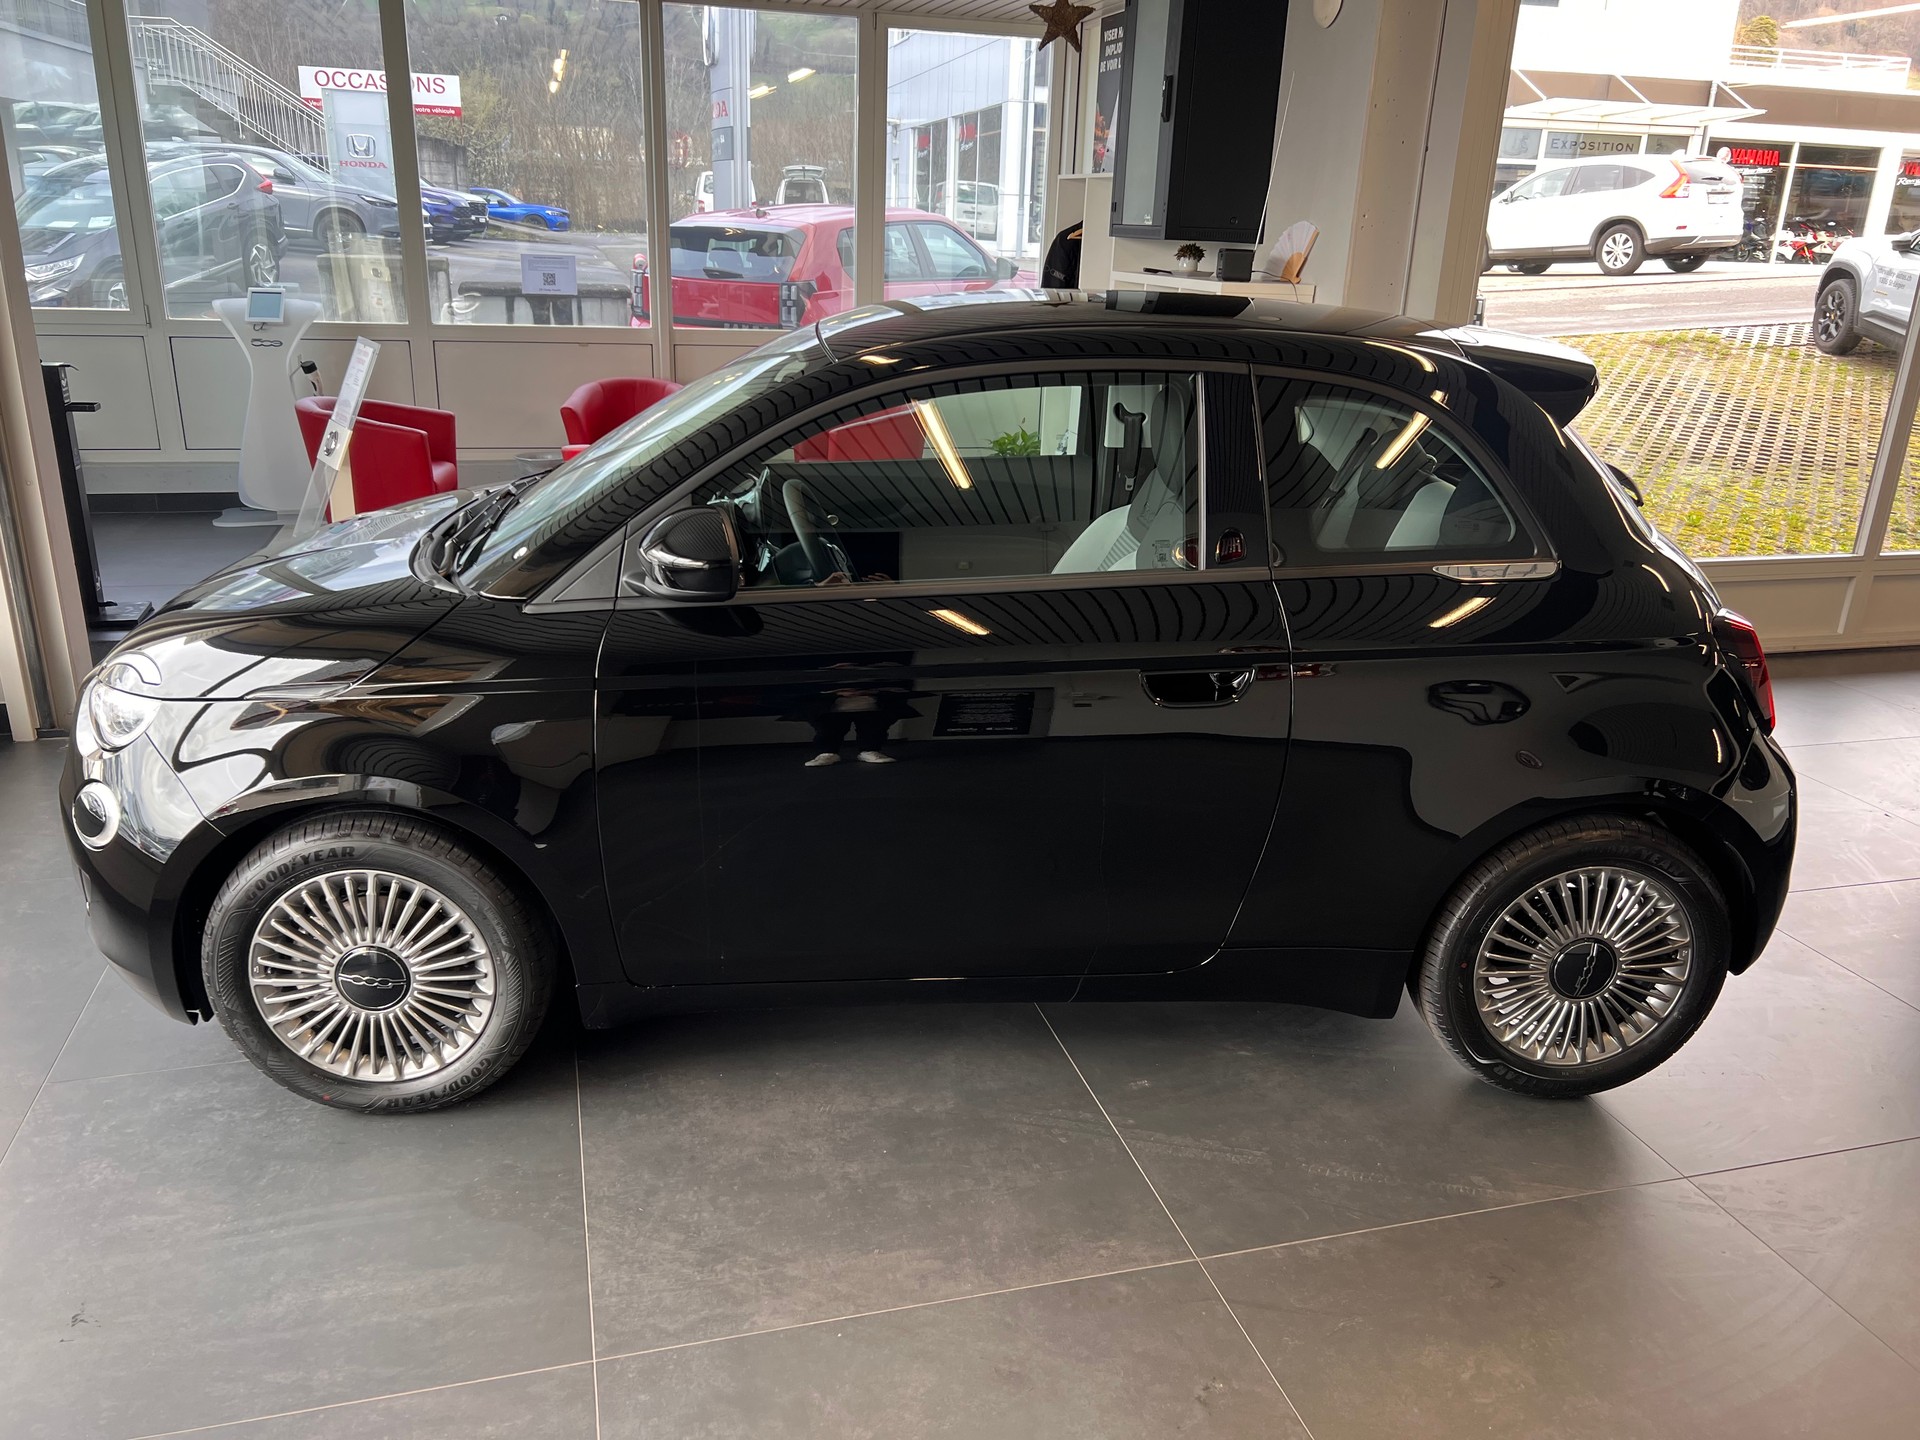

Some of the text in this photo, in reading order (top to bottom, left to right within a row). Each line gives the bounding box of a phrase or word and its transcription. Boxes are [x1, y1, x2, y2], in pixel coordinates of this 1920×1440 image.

[314, 70, 446, 94] OCCASNS
[432, 106, 456, 114] véhicule
[1550, 138, 1635, 152] EXPOSITION
[1731, 148, 1780, 166] YAMAHA
[339, 160, 388, 169] HONDA
